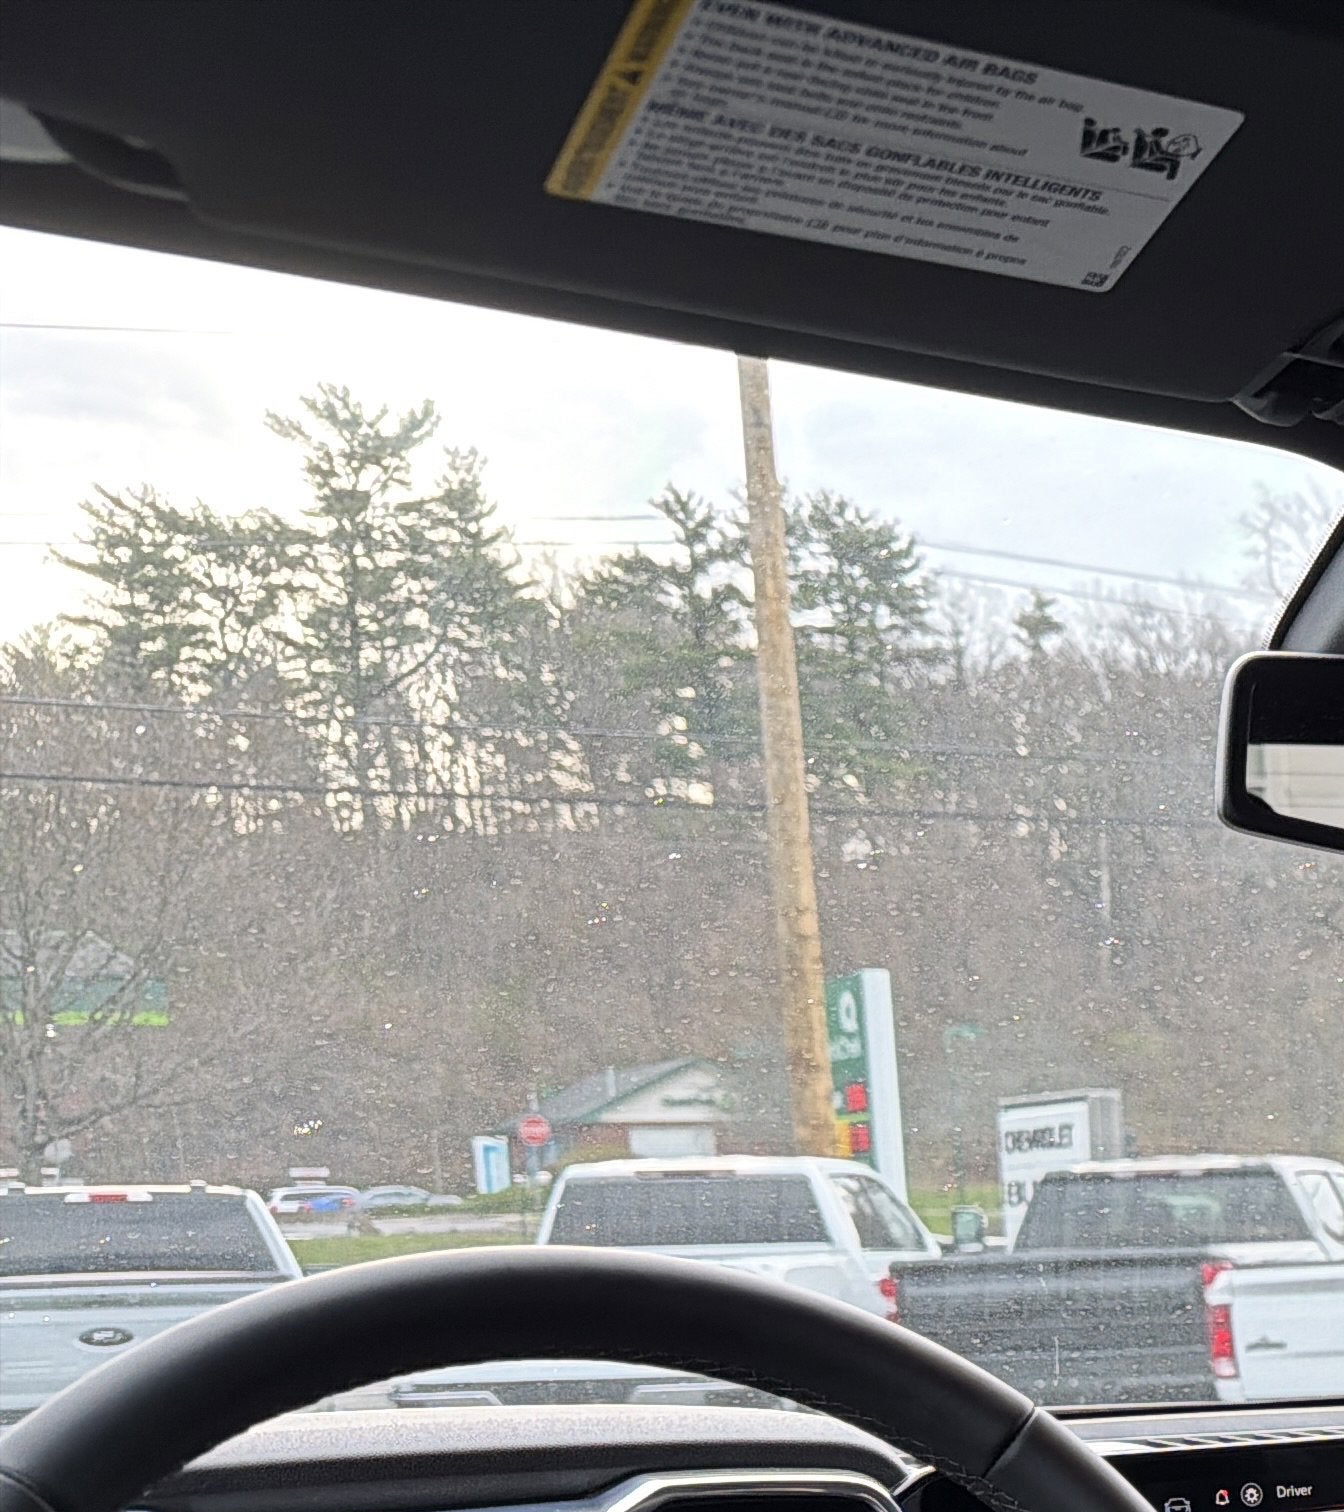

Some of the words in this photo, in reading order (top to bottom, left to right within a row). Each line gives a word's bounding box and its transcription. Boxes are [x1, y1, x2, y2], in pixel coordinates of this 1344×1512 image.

[982, 63, 1038, 85] BAGS
[983, 168, 1104, 201] INTELLIGENTS
[1275, 1485, 1313, 1499] Driver
